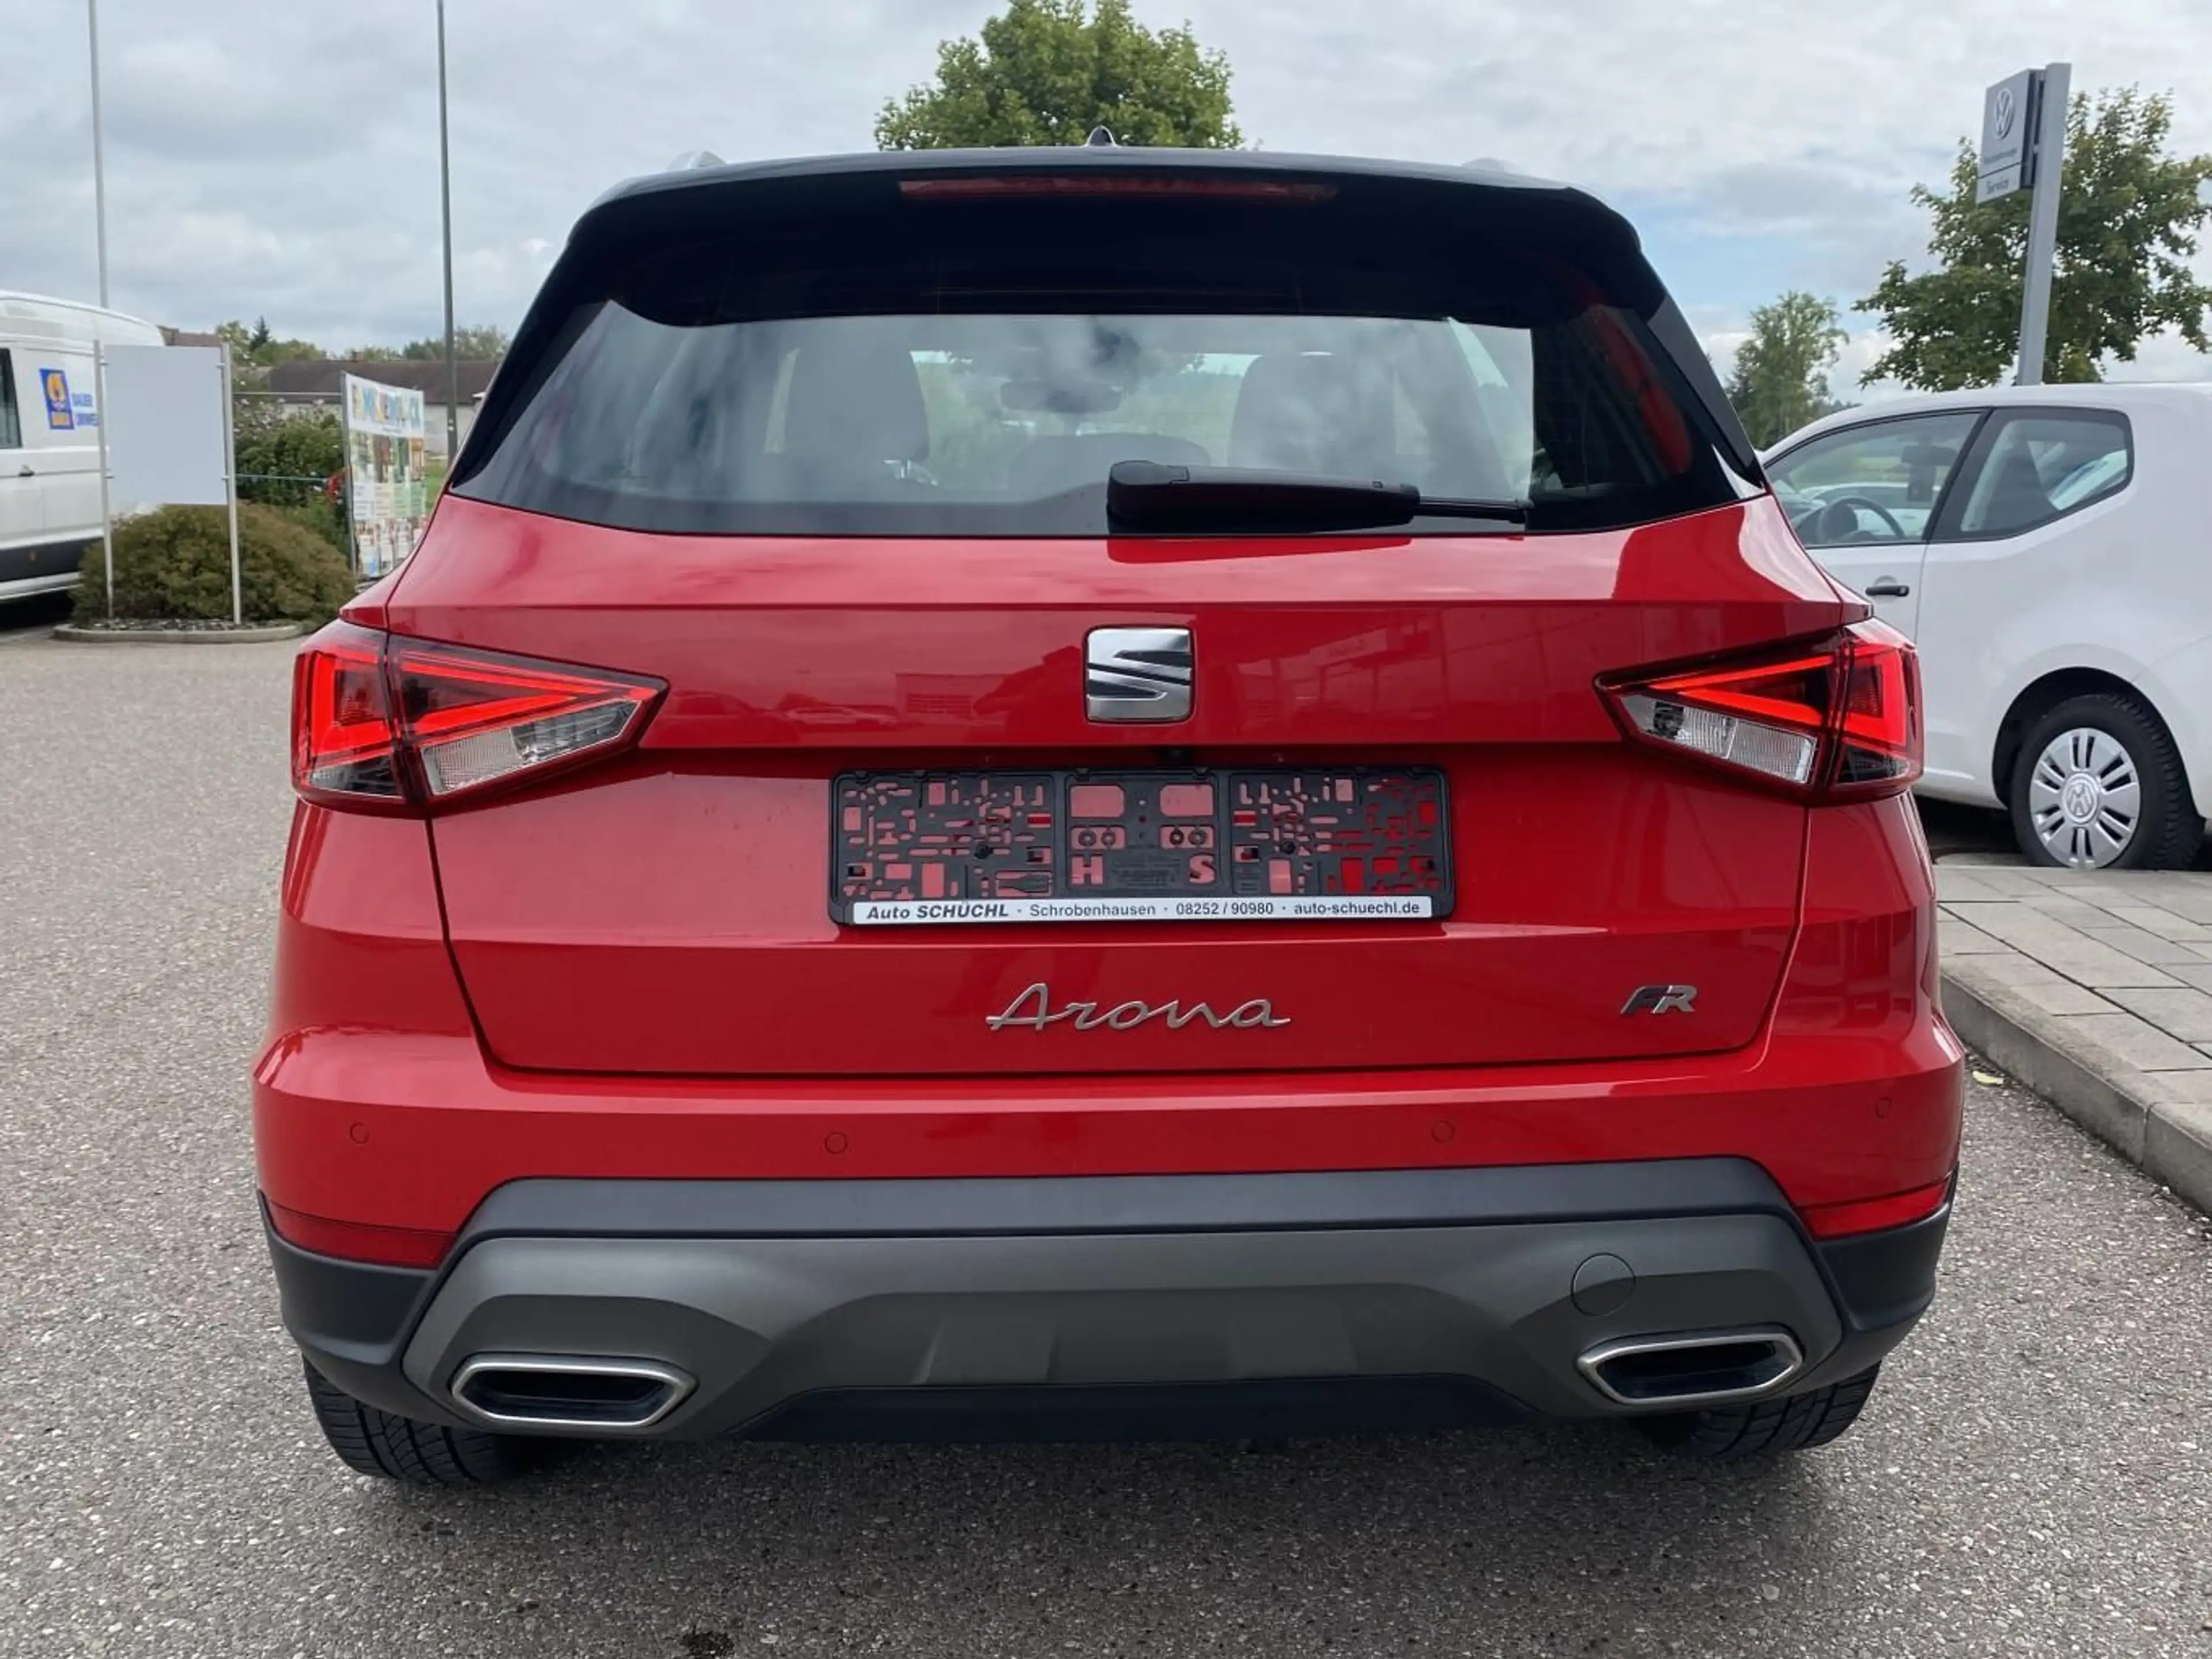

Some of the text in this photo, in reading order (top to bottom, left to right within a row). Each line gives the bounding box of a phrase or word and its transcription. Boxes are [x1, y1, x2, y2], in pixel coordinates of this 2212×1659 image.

[866, 906, 910, 920] Auto
[917, 901, 1009, 919] SCHÜCHL
[1030, 903, 1156, 917] Schrobenhausen
[1175, 902, 1219, 915] 08252
[1231, 902, 1274, 915] 90980
[1294, 901, 1420, 915] auto-schuechl.de
[985, 982, 1291, 1031] Arona
[1620, 984, 1697, 1014] FR
